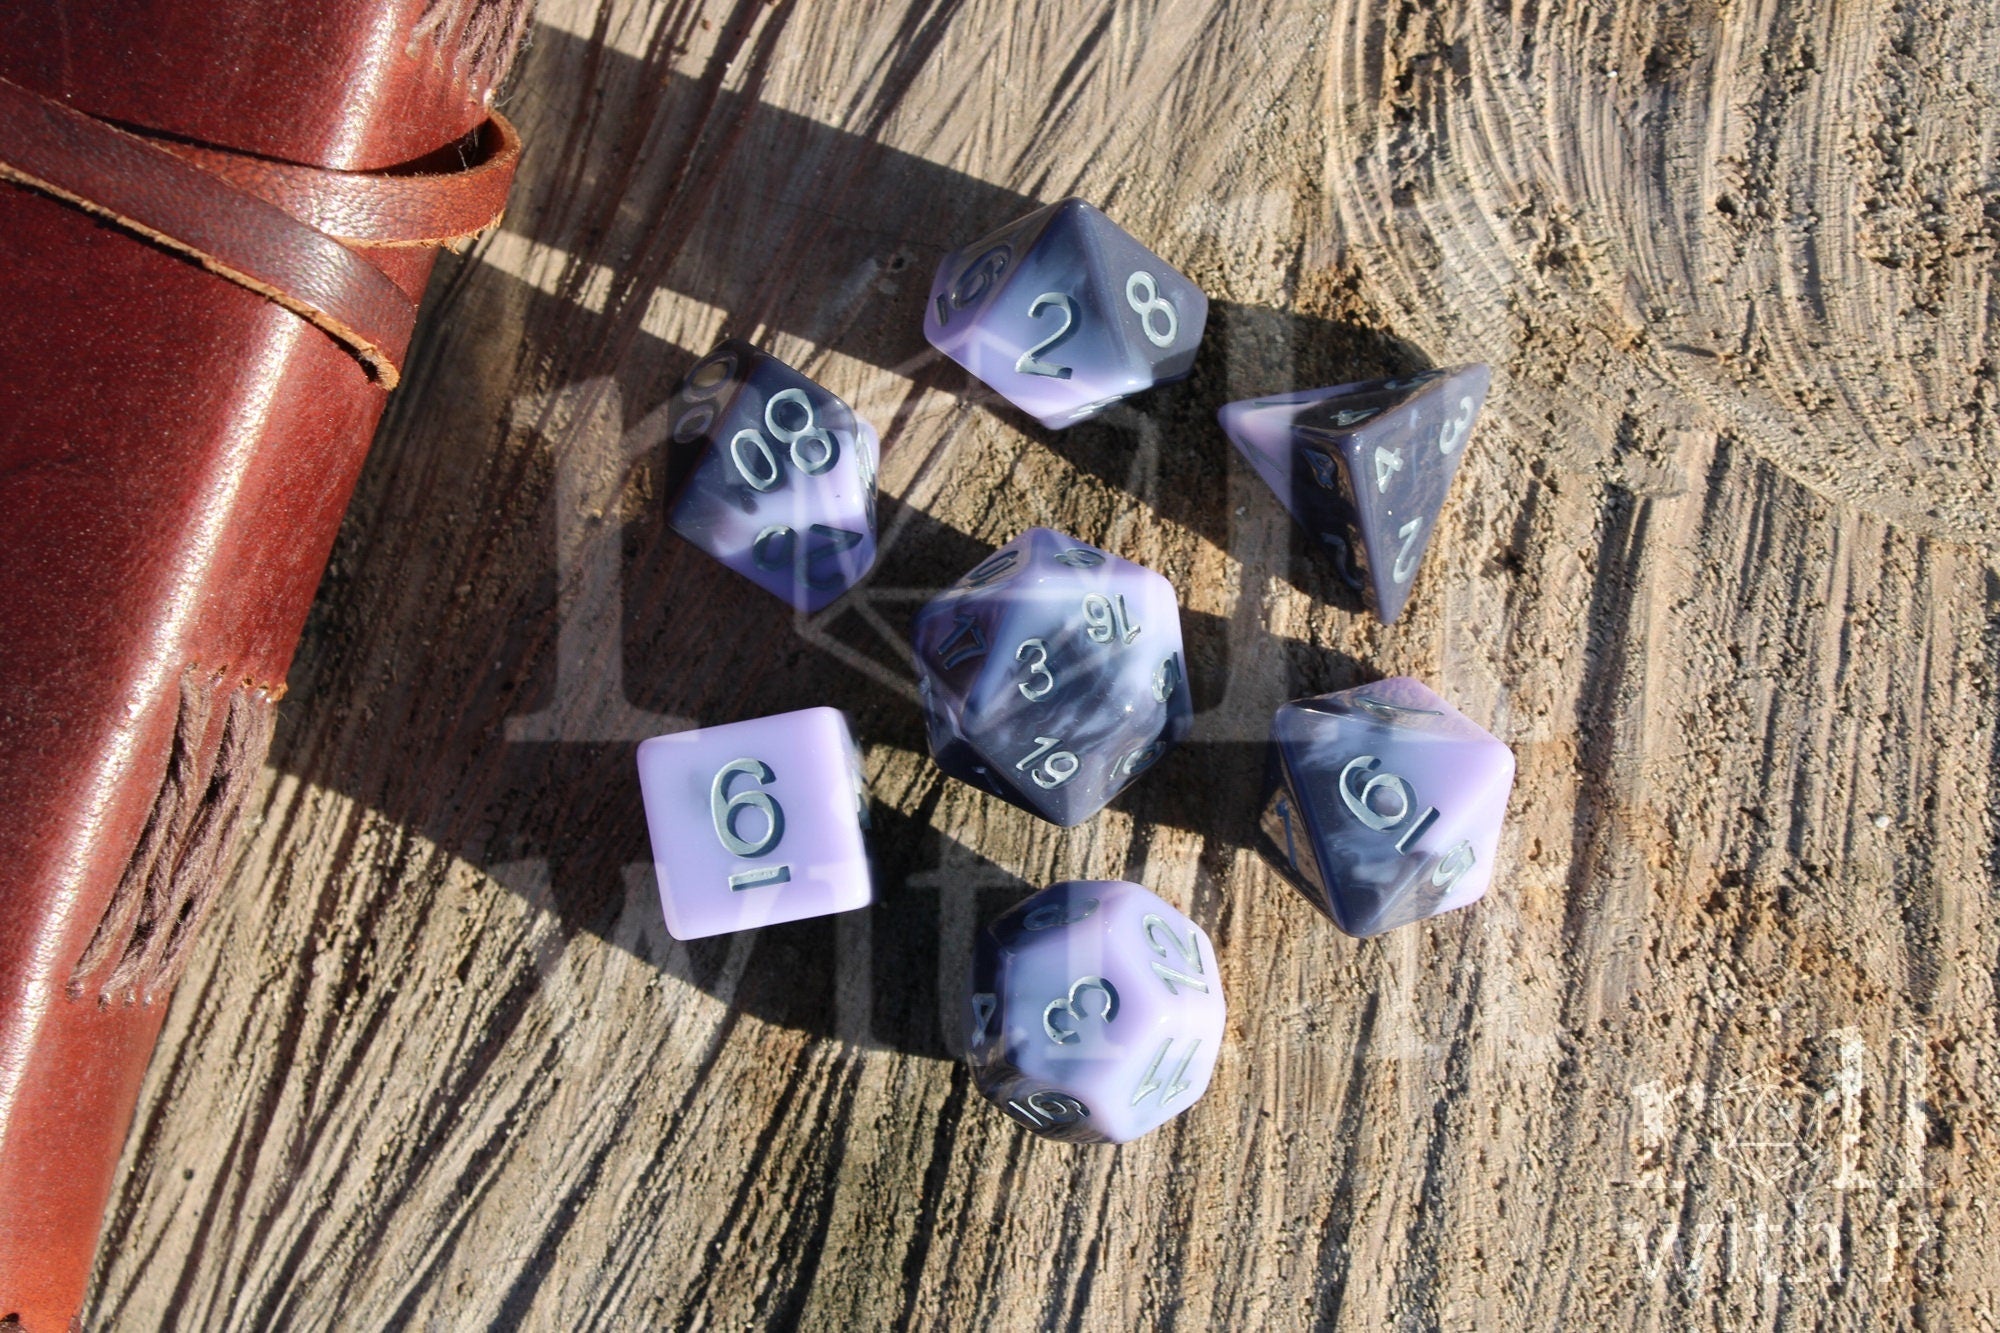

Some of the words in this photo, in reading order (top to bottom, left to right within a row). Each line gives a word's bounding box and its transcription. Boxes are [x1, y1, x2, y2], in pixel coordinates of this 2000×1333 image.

[1015, 292, 1082, 380] 2
[1126, 271, 1178, 348] 8
[1439, 396, 1474, 455] 3
[1375, 446, 1403, 494] 4
[1393, 516, 1423, 584] 2
[1082, 593, 1141, 646] 16
[1015, 638, 1054, 702] 3
[1016, 736, 1082, 790] 19
[711, 757, 791, 892] 6
[1339, 755, 1440, 855] 6
[1142, 914, 1209, 994] 12
[1043, 976, 1120, 1045] 3
[1131, 1037, 1202, 1107] 11
